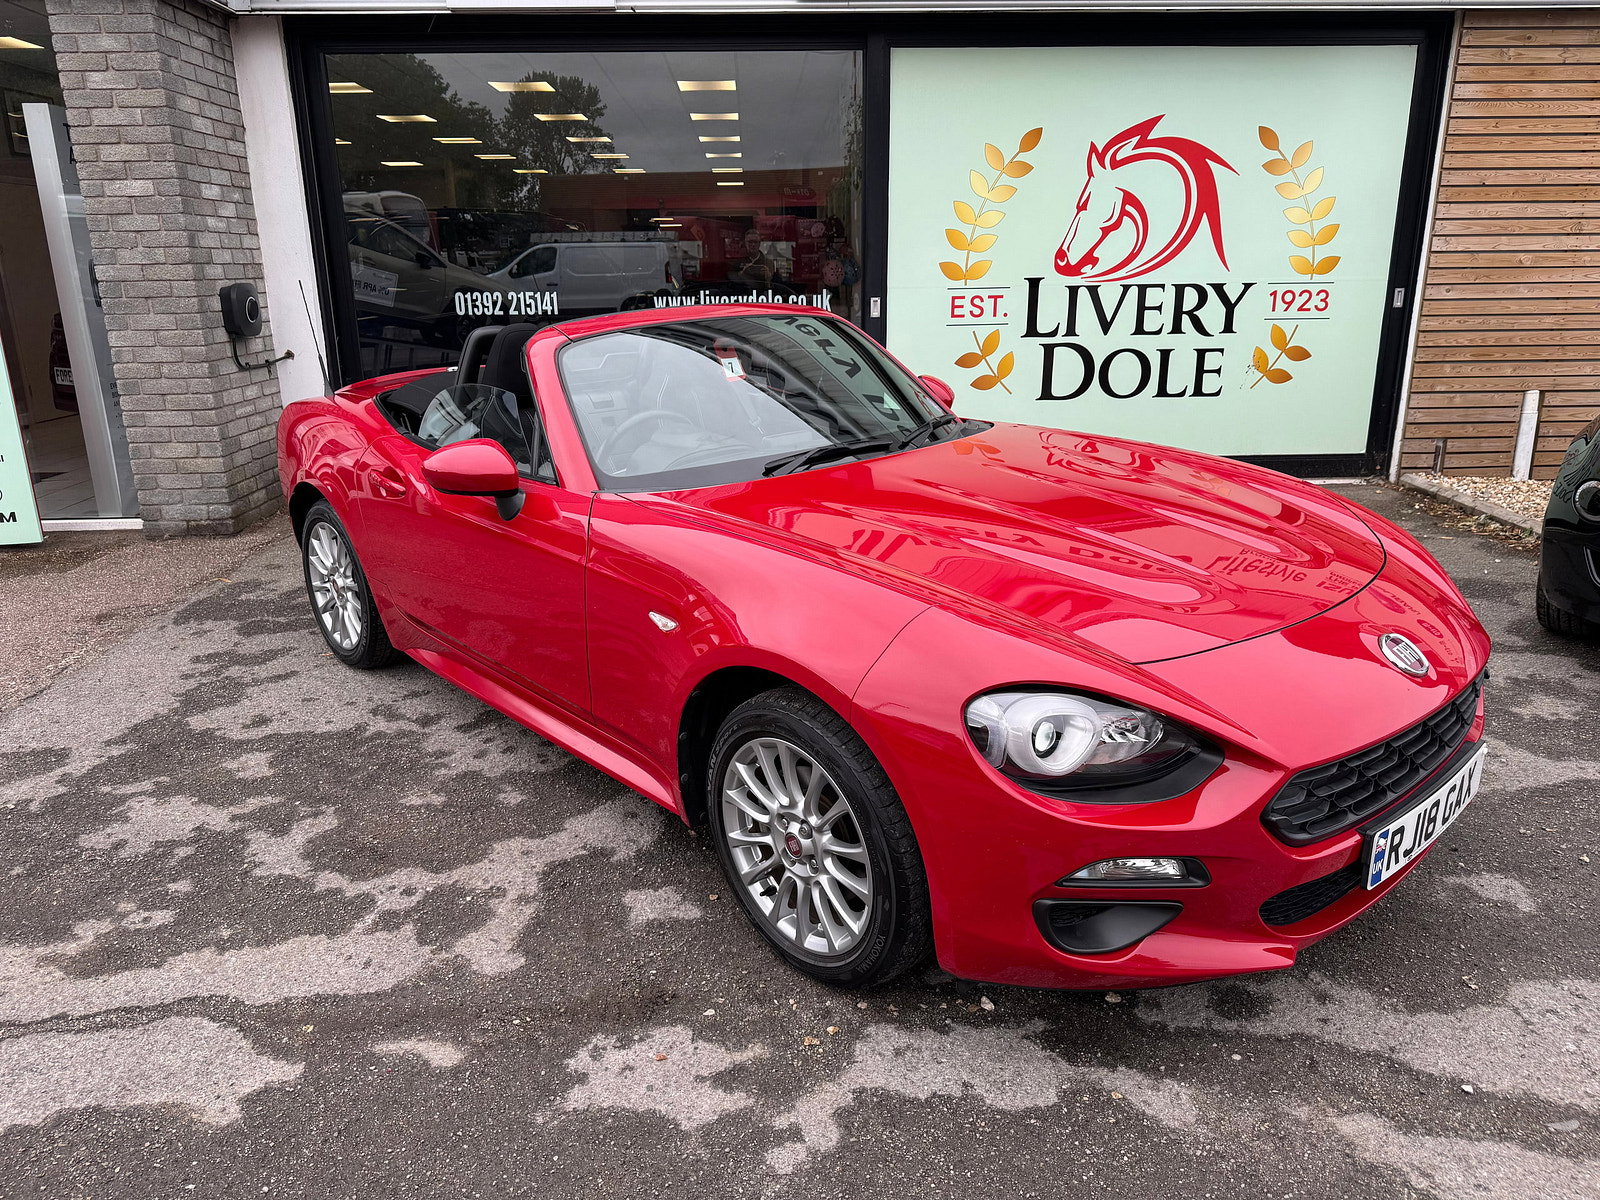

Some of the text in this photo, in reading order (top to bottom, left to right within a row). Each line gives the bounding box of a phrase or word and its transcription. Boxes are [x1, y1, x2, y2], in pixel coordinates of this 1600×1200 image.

[454, 291, 559, 316] 01392 215141
[653, 289, 833, 312] wwwlidlcouk
[950, 295, 1009, 319] EST.
[1020, 277, 1257, 338] LIVERY
[1269, 289, 1330, 313] 1923
[1035, 342, 1225, 401] DOLE
[1385, 760, 1478, 872] RJ18 GAX
[1372, 859, 1384, 875] UK
[855, 934, 887, 974] YOKOHAMA
